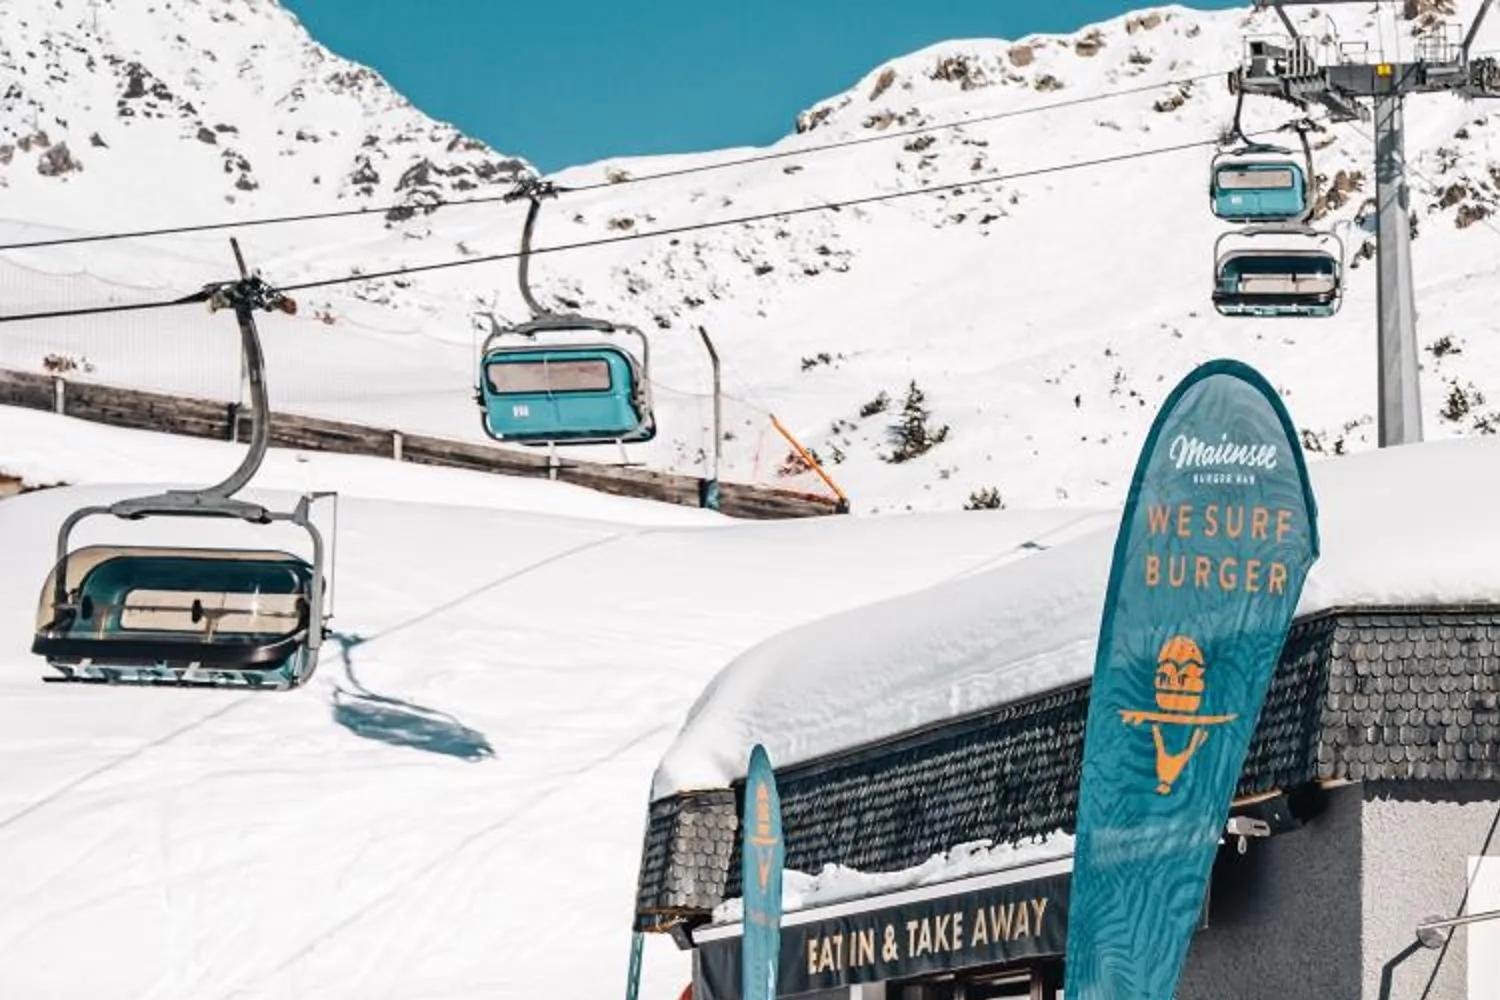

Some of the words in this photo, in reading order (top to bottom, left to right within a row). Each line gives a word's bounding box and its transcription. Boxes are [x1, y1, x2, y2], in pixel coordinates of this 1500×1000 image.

[1169, 432, 1278, 470] Maiensee
[1148, 503, 1194, 537] WE
[1204, 503, 1292, 543] SURF
[1145, 554, 1287, 594] BURGER
[807, 934, 843, 976] EAT
[850, 928, 875, 968] IN
[882, 924, 898, 962] &
[906, 912, 963, 958] TAKE
[970, 898, 1048, 948] AWAY
